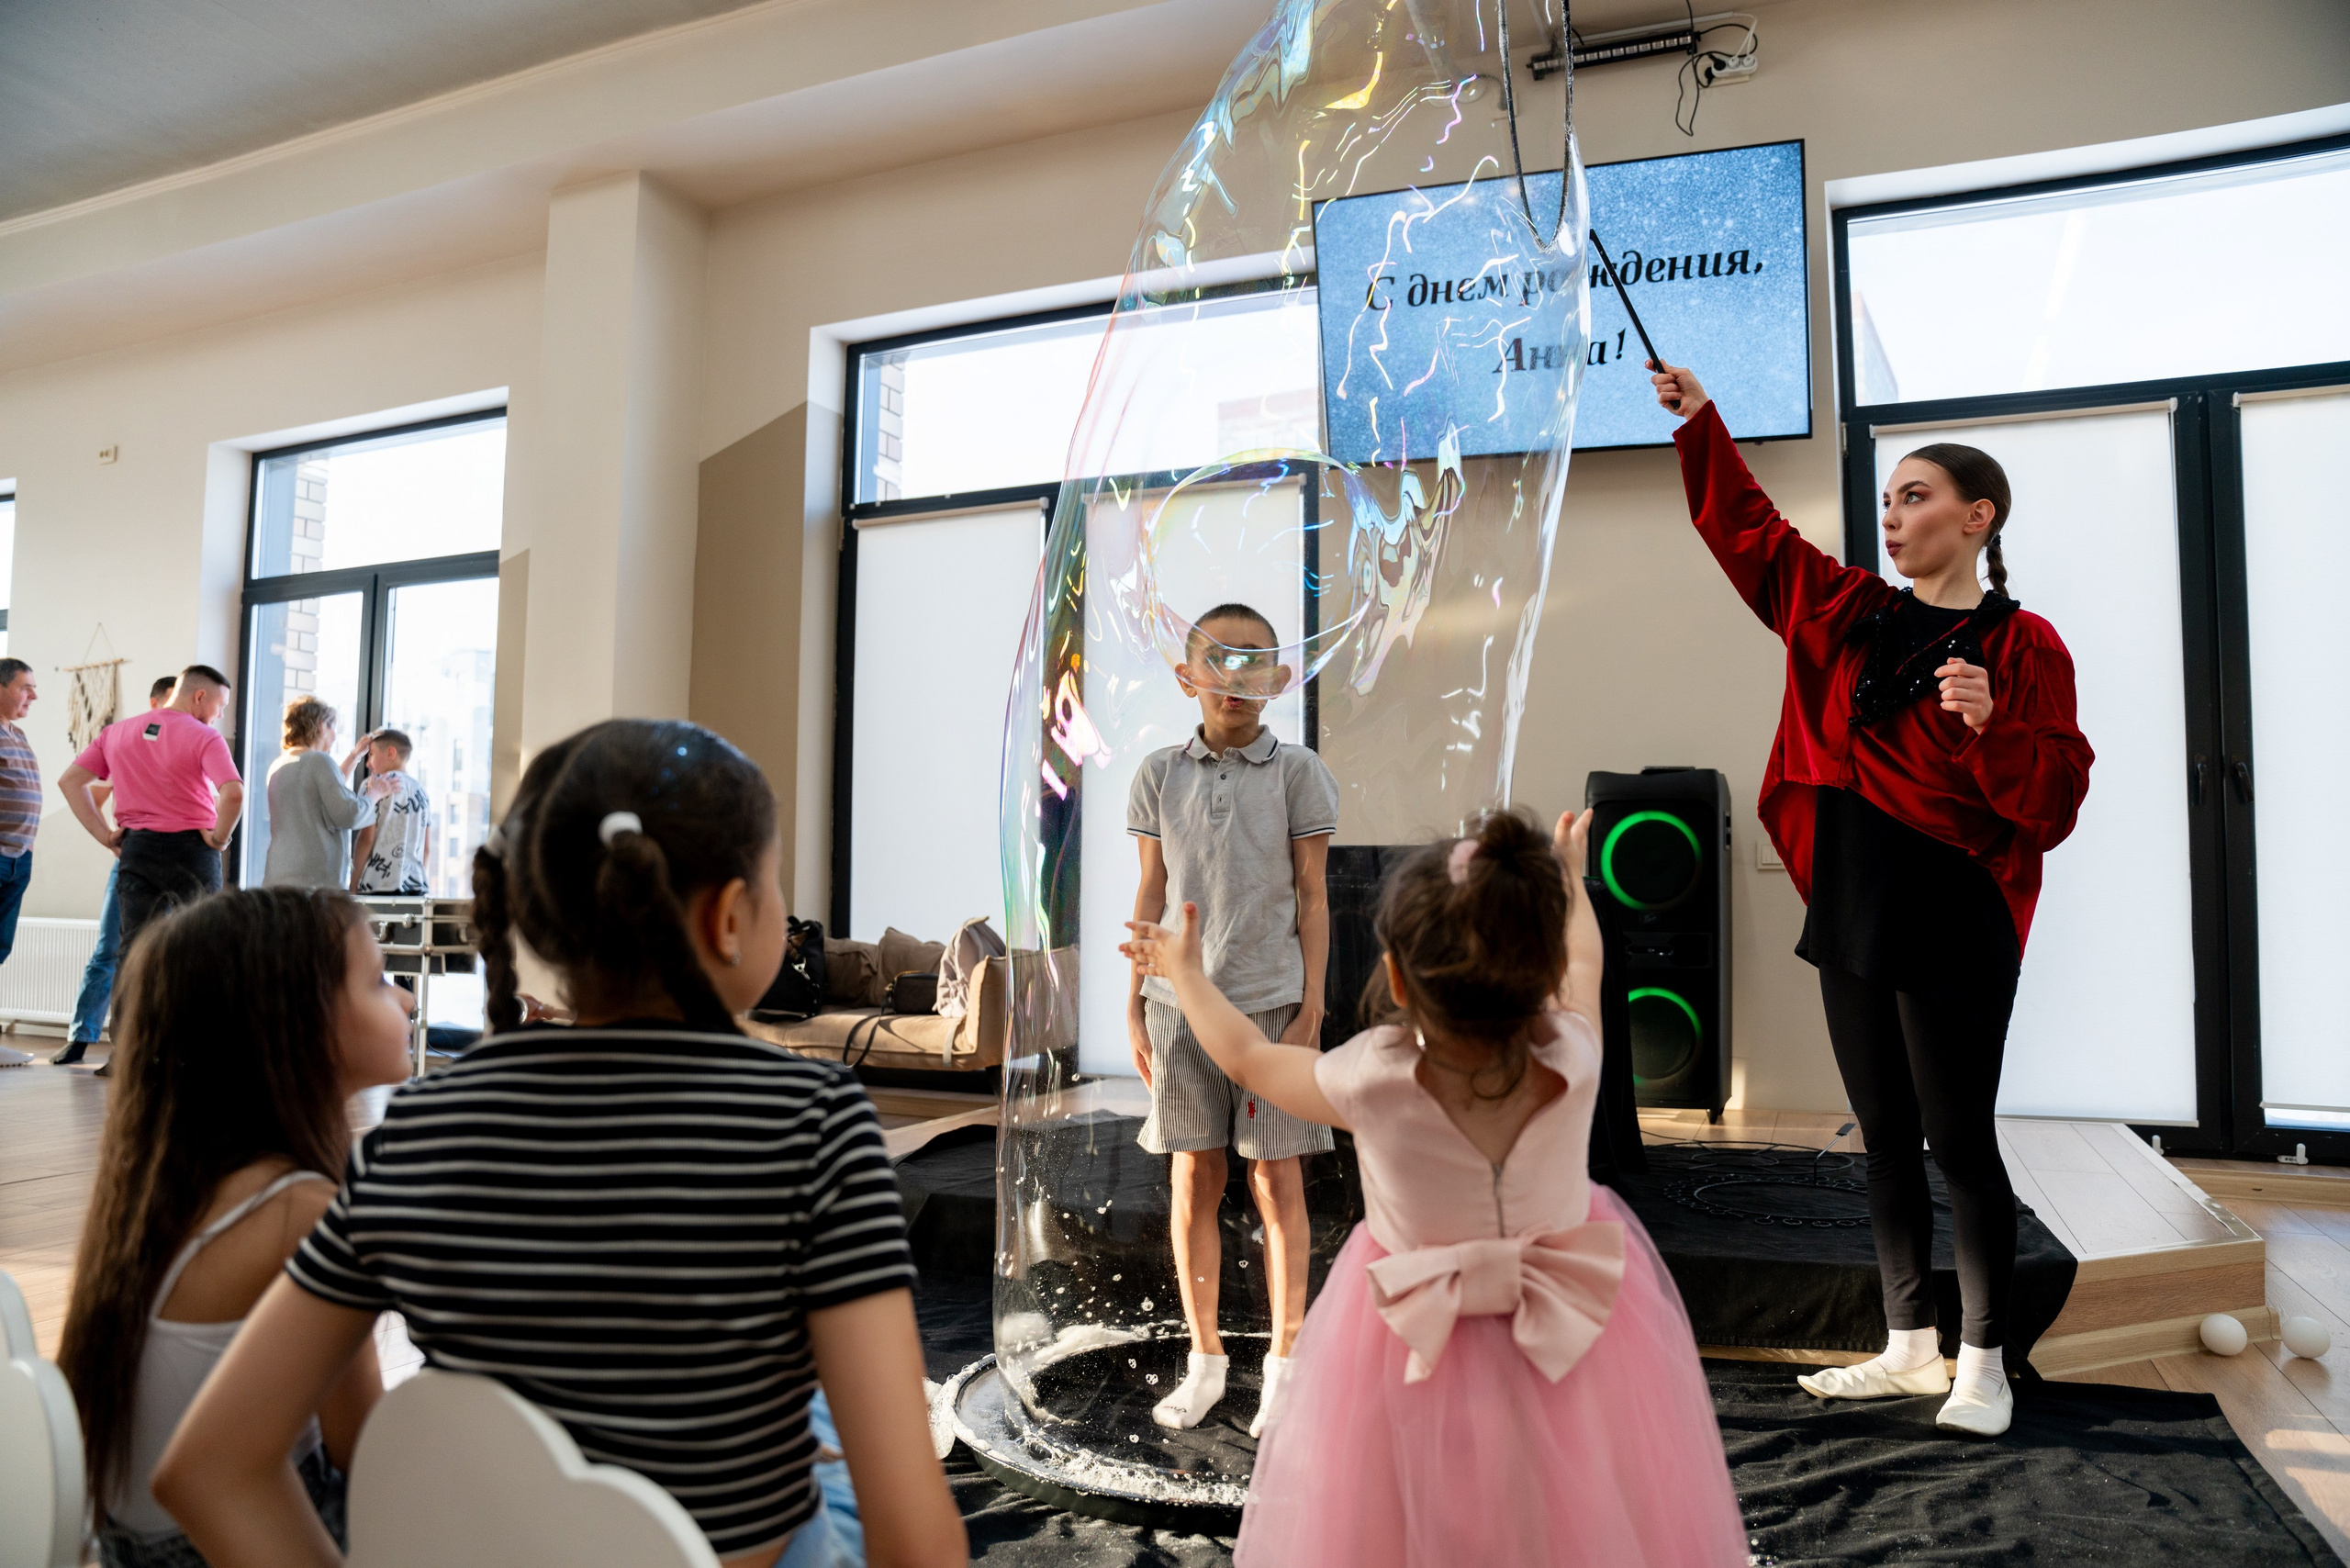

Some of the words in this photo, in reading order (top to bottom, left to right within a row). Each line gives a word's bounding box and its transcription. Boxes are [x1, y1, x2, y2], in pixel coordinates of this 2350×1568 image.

[1366, 275, 1395, 310] С
[1407, 274, 1508, 308] днем
[1492, 328, 1626, 374] Ана!
